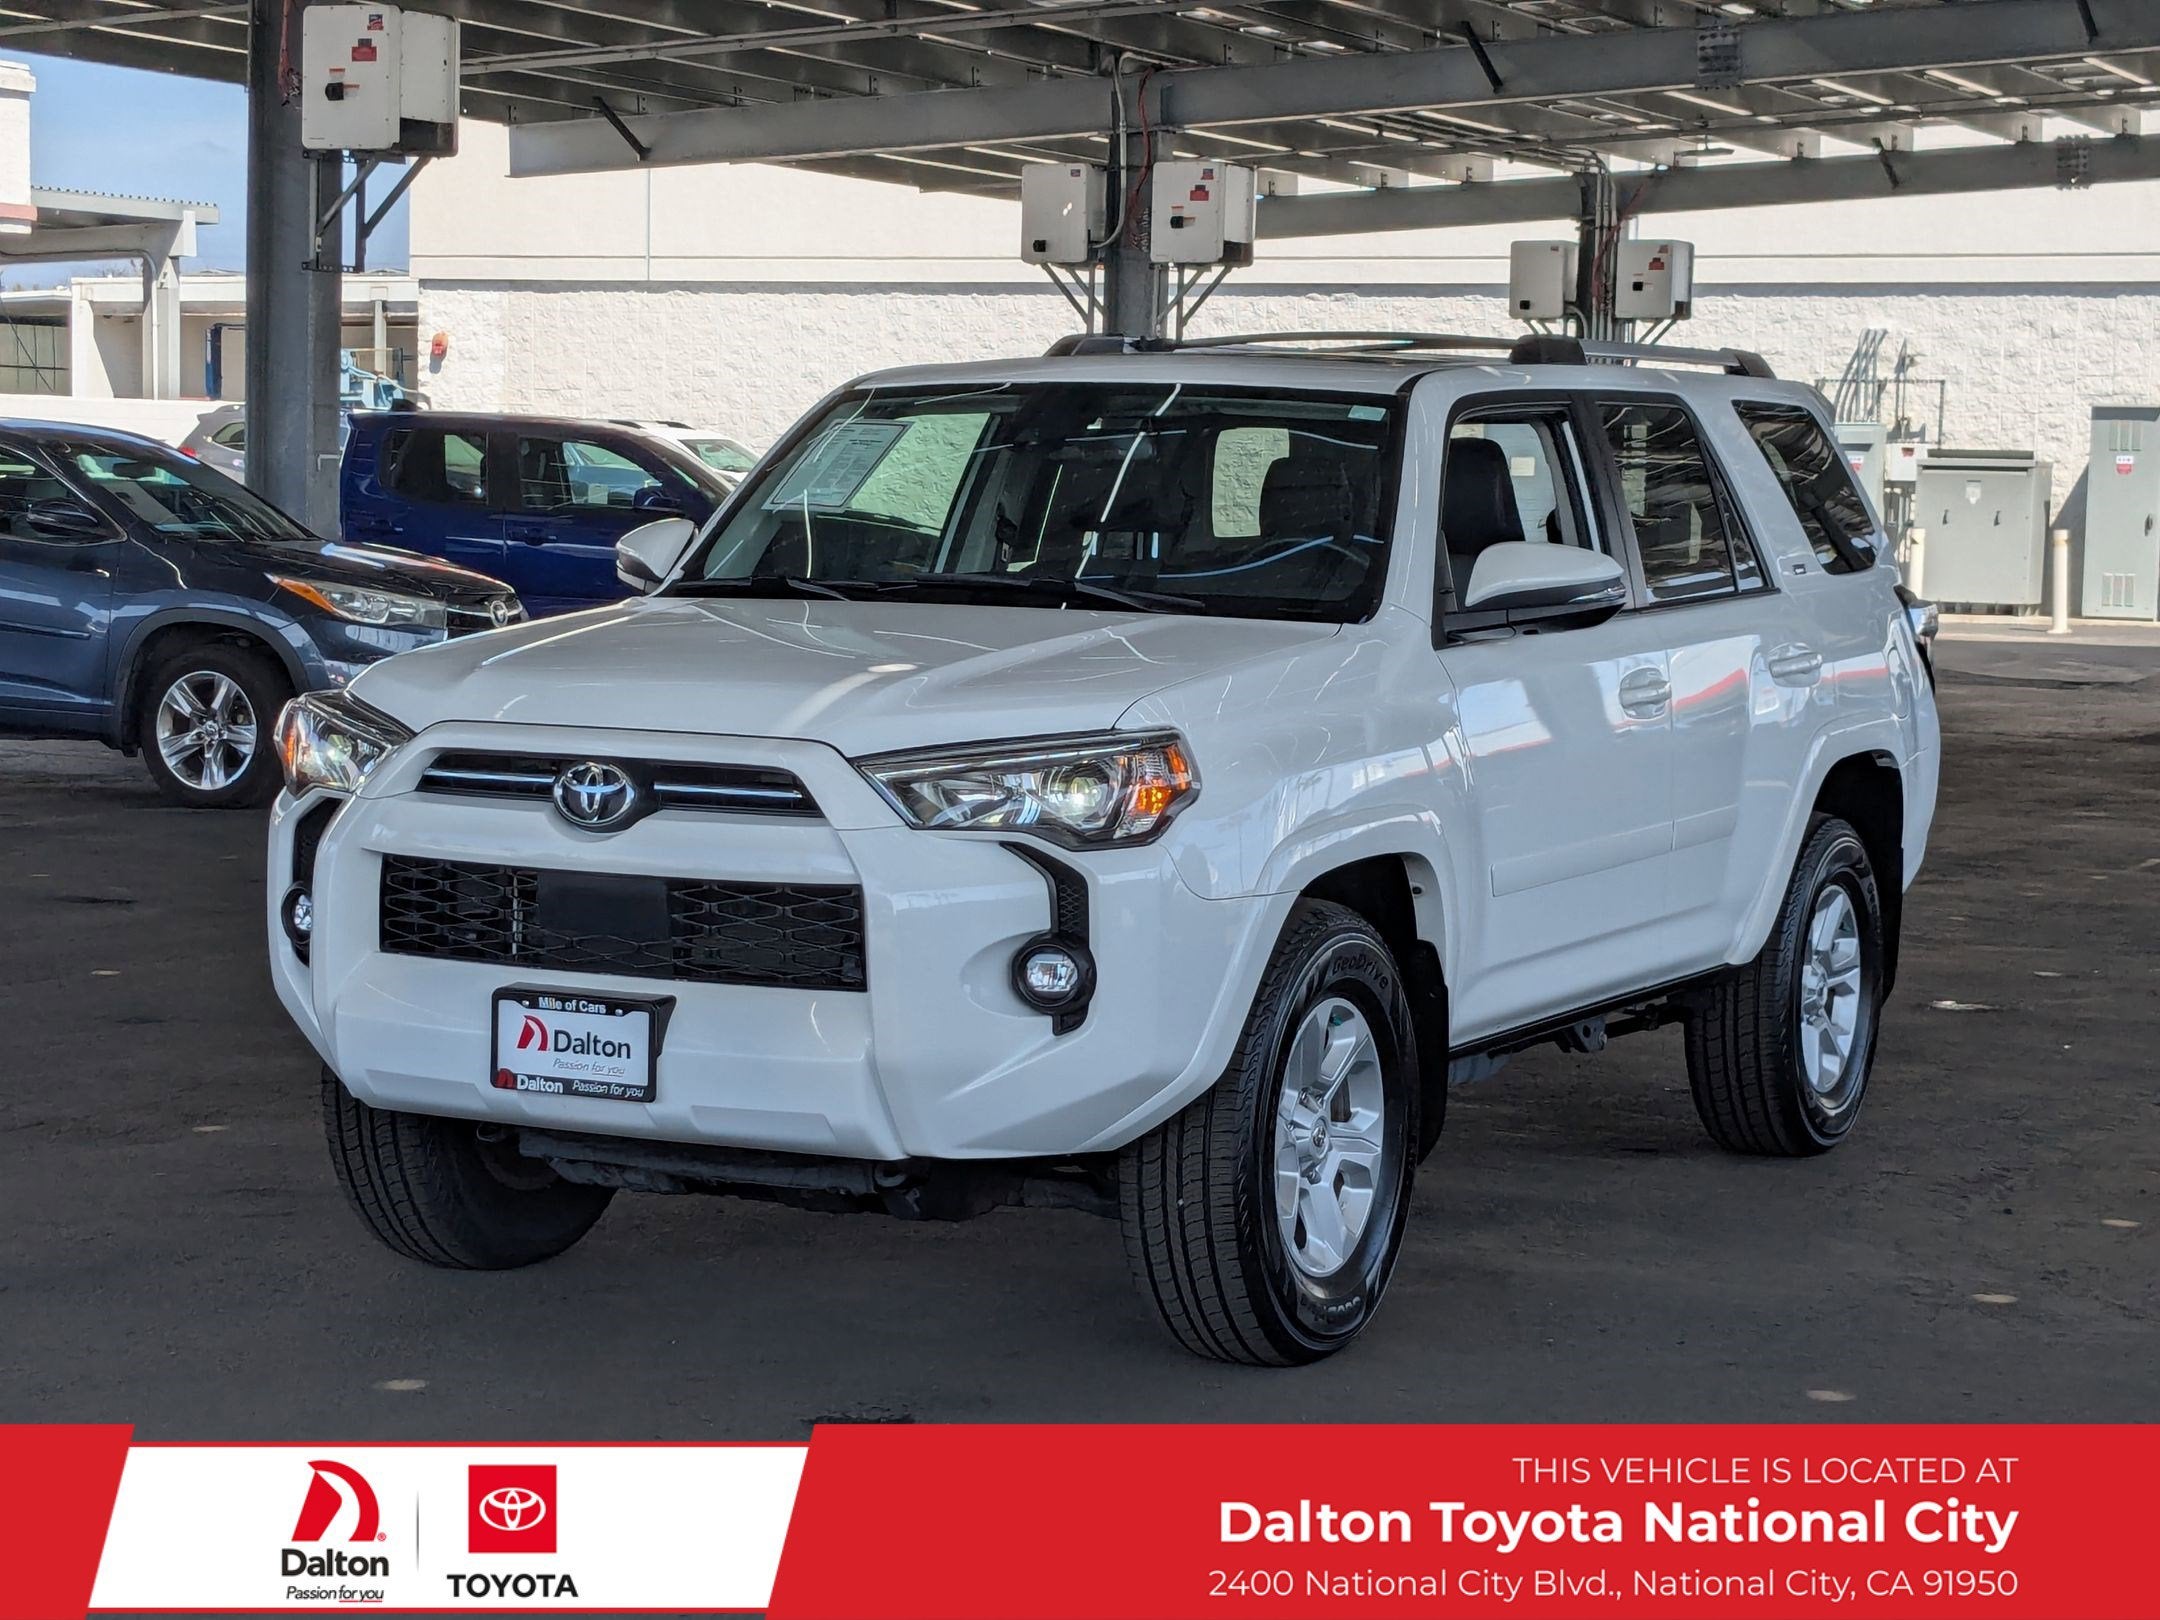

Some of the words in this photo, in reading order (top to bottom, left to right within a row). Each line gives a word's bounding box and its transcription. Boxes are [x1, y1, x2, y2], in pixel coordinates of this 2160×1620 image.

[538, 996, 563, 1010] Mile
[566, 998, 577, 1011] of
[580, 999, 607, 1014] Cars
[553, 1029, 631, 1059] Dalton
[553, 1058, 589, 1071] Passion
[592, 1061, 605, 1074] for
[607, 1065, 626, 1076] you
[517, 1074, 563, 1093] Dalton
[572, 1080, 608, 1093] Passion
[609, 1083, 625, 1096] for
[625, 1087, 645, 1099] you
